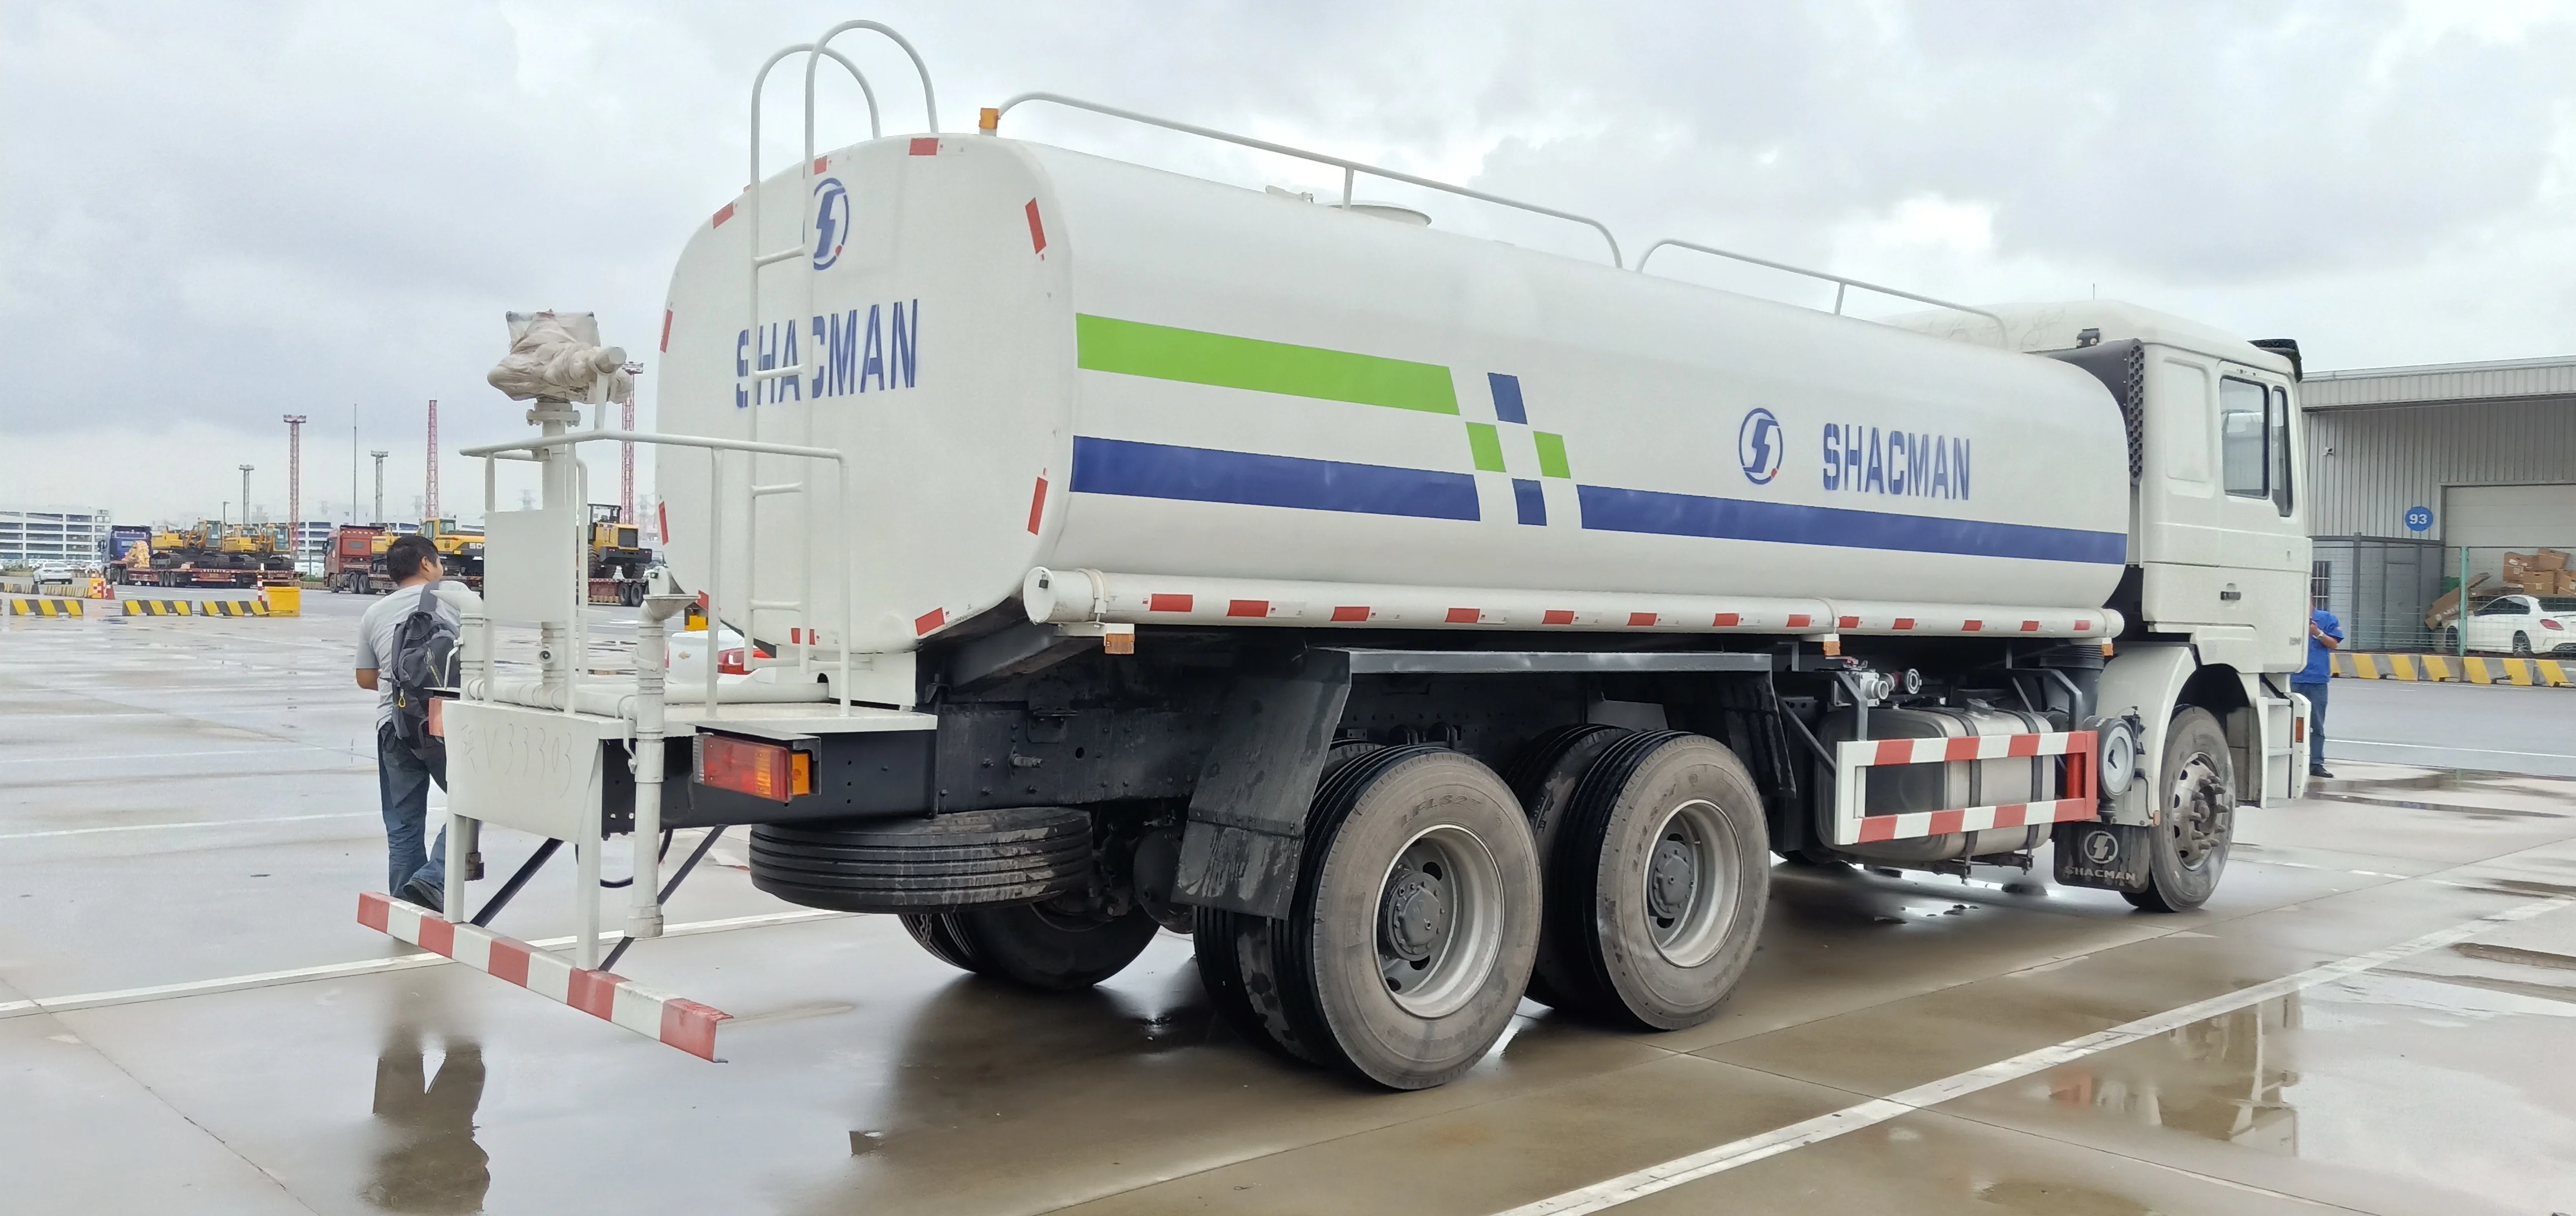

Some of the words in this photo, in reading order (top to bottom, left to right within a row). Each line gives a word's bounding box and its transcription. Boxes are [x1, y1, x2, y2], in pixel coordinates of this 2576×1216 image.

[736, 298, 918, 408] SHACMAN
[1822, 422, 1970, 500] SHACMAN
[2409, 513, 2427, 525] 93
[2064, 866, 2136, 881] SHACMAN
